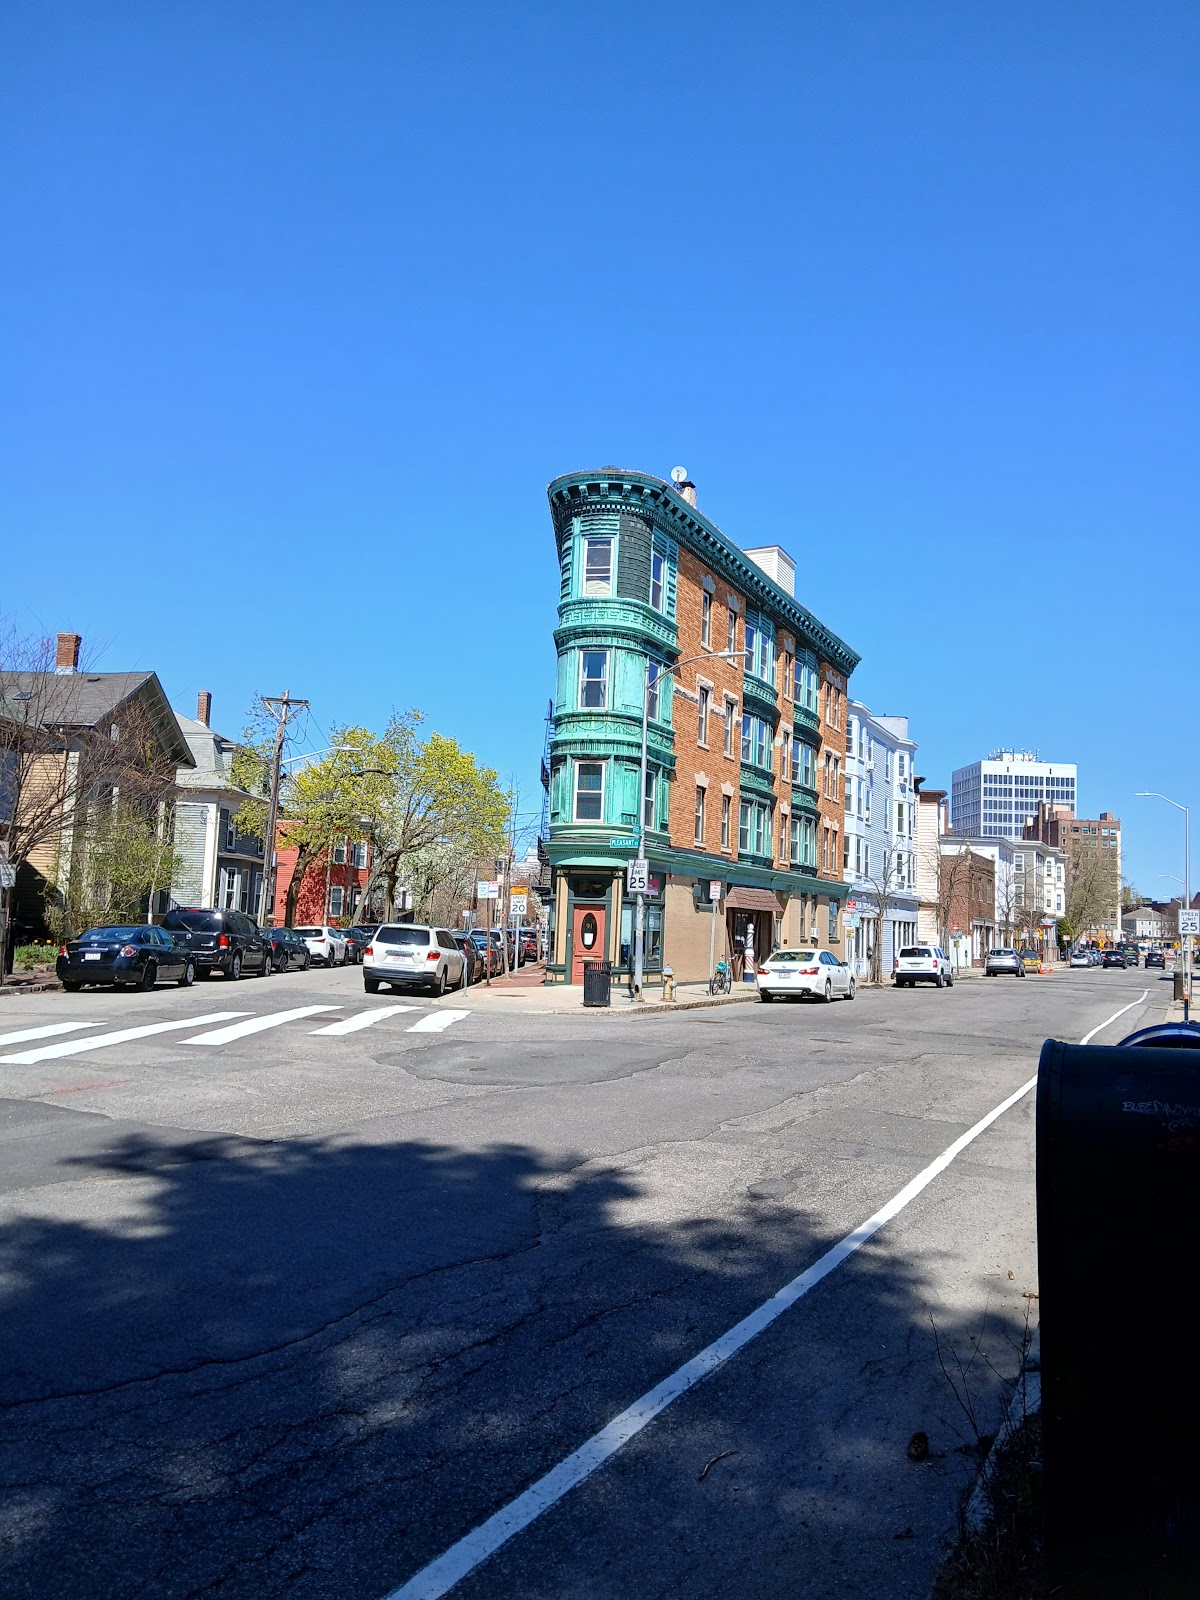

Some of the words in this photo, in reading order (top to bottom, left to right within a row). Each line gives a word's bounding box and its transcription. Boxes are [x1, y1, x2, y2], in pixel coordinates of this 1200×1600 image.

[630, 877, 646, 889] 25
[512, 904, 525, 912] 20
[1181, 922, 1198, 931] 25
